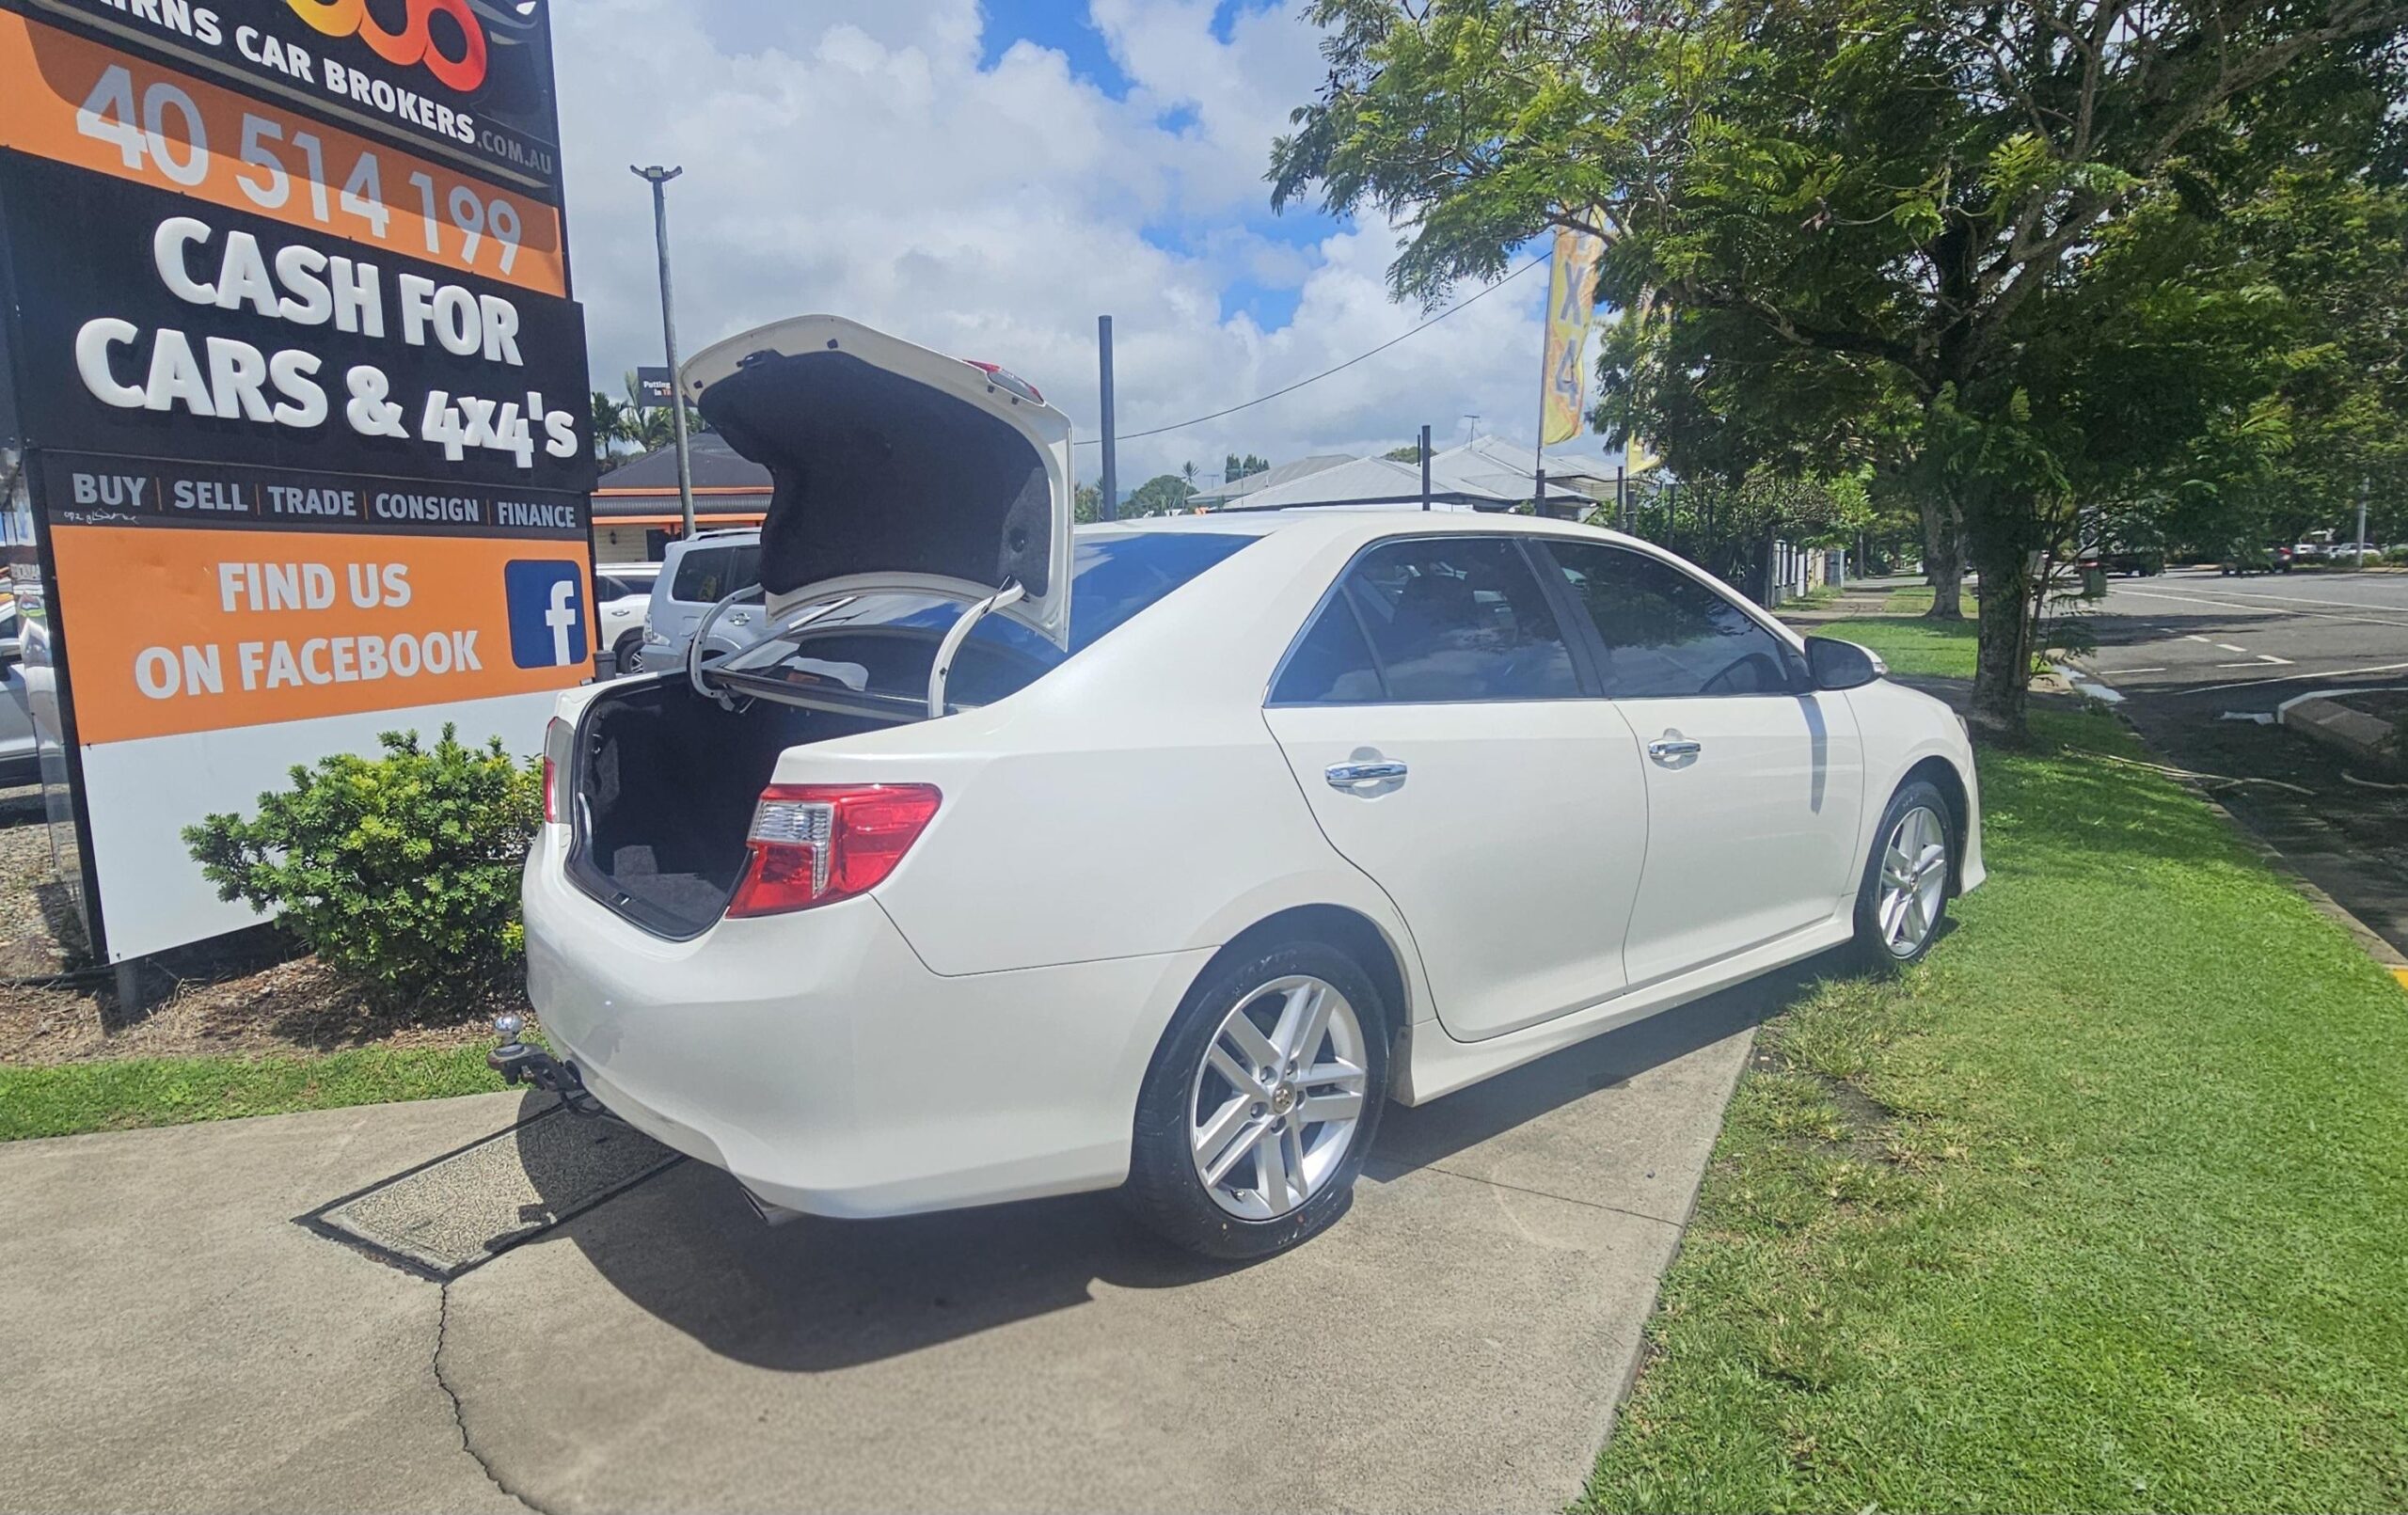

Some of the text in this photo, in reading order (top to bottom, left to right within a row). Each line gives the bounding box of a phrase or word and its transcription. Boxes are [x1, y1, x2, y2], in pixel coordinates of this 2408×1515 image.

[236, 25, 315, 84] CAR
[75, 65, 521, 276] 40 514 199
[153, 216, 524, 366] CASH FOR
[76, 317, 328, 428] CARS
[346, 365, 410, 439] &
[72, 473, 577, 528] BUY SELL TRADE CONSIGN FINANCE
[217, 562, 412, 613] FIND US
[546, 580, 577, 667] f
[135, 631, 483, 700] ON FACEBOOK
